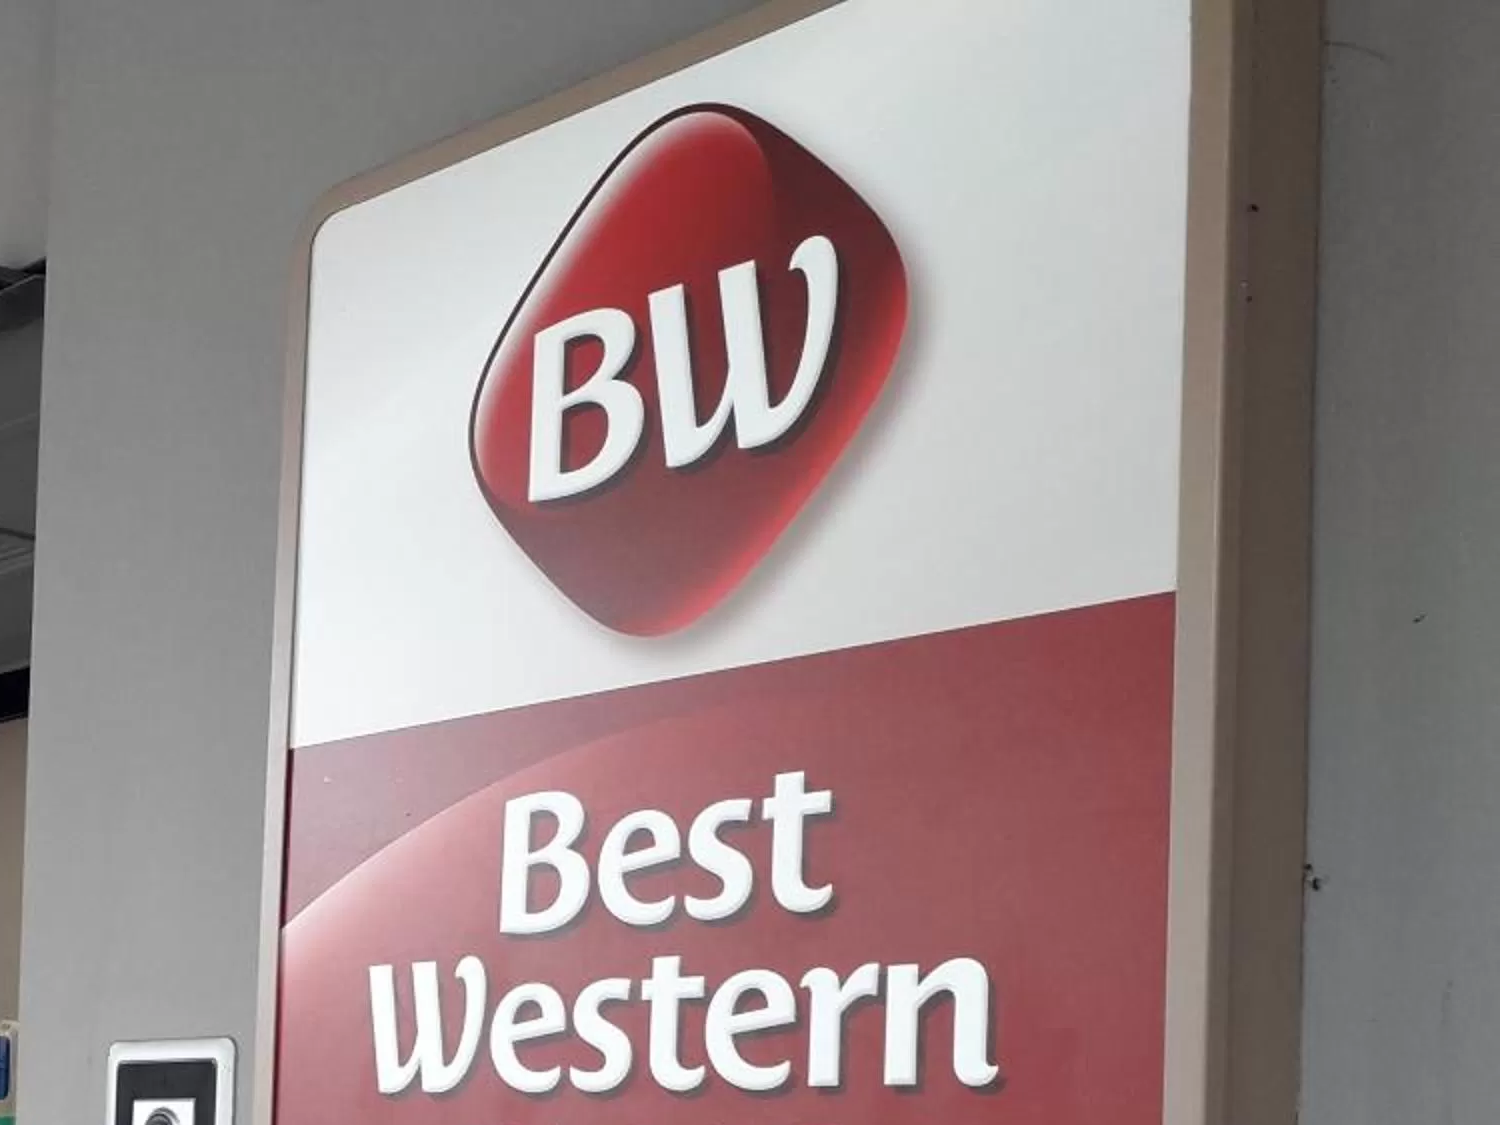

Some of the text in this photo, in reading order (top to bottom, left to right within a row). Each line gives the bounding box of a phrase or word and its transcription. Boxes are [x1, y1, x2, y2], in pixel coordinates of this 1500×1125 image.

[527, 234, 840, 503] BW
[500, 771, 833, 934] Best
[369, 956, 998, 1093] Western
